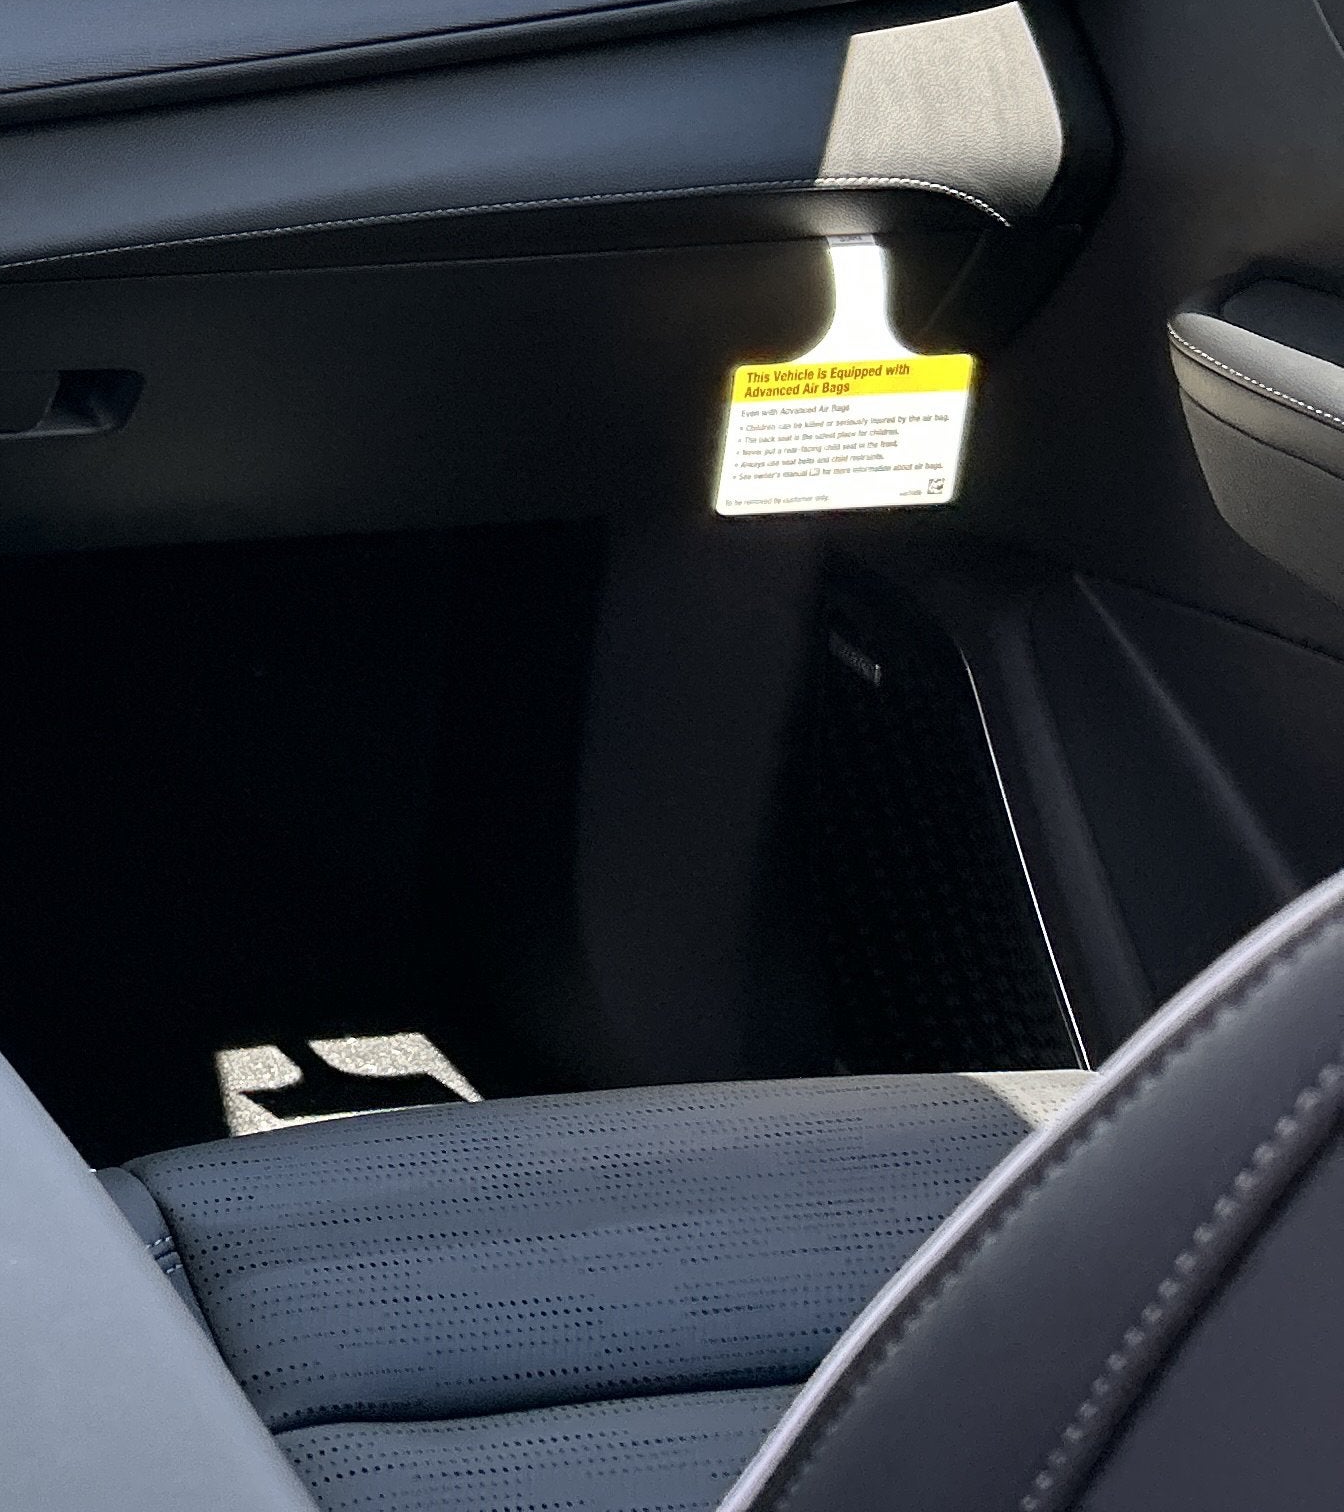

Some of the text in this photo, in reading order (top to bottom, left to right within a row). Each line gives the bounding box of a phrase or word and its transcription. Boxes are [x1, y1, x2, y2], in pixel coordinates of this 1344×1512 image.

[747, 372, 770, 383] This
[773, 370, 814, 382] Vehicle
[830, 365, 883, 380] Equipped
[885, 364, 911, 376] with
[744, 382, 850, 399] Advanced Air Bags
